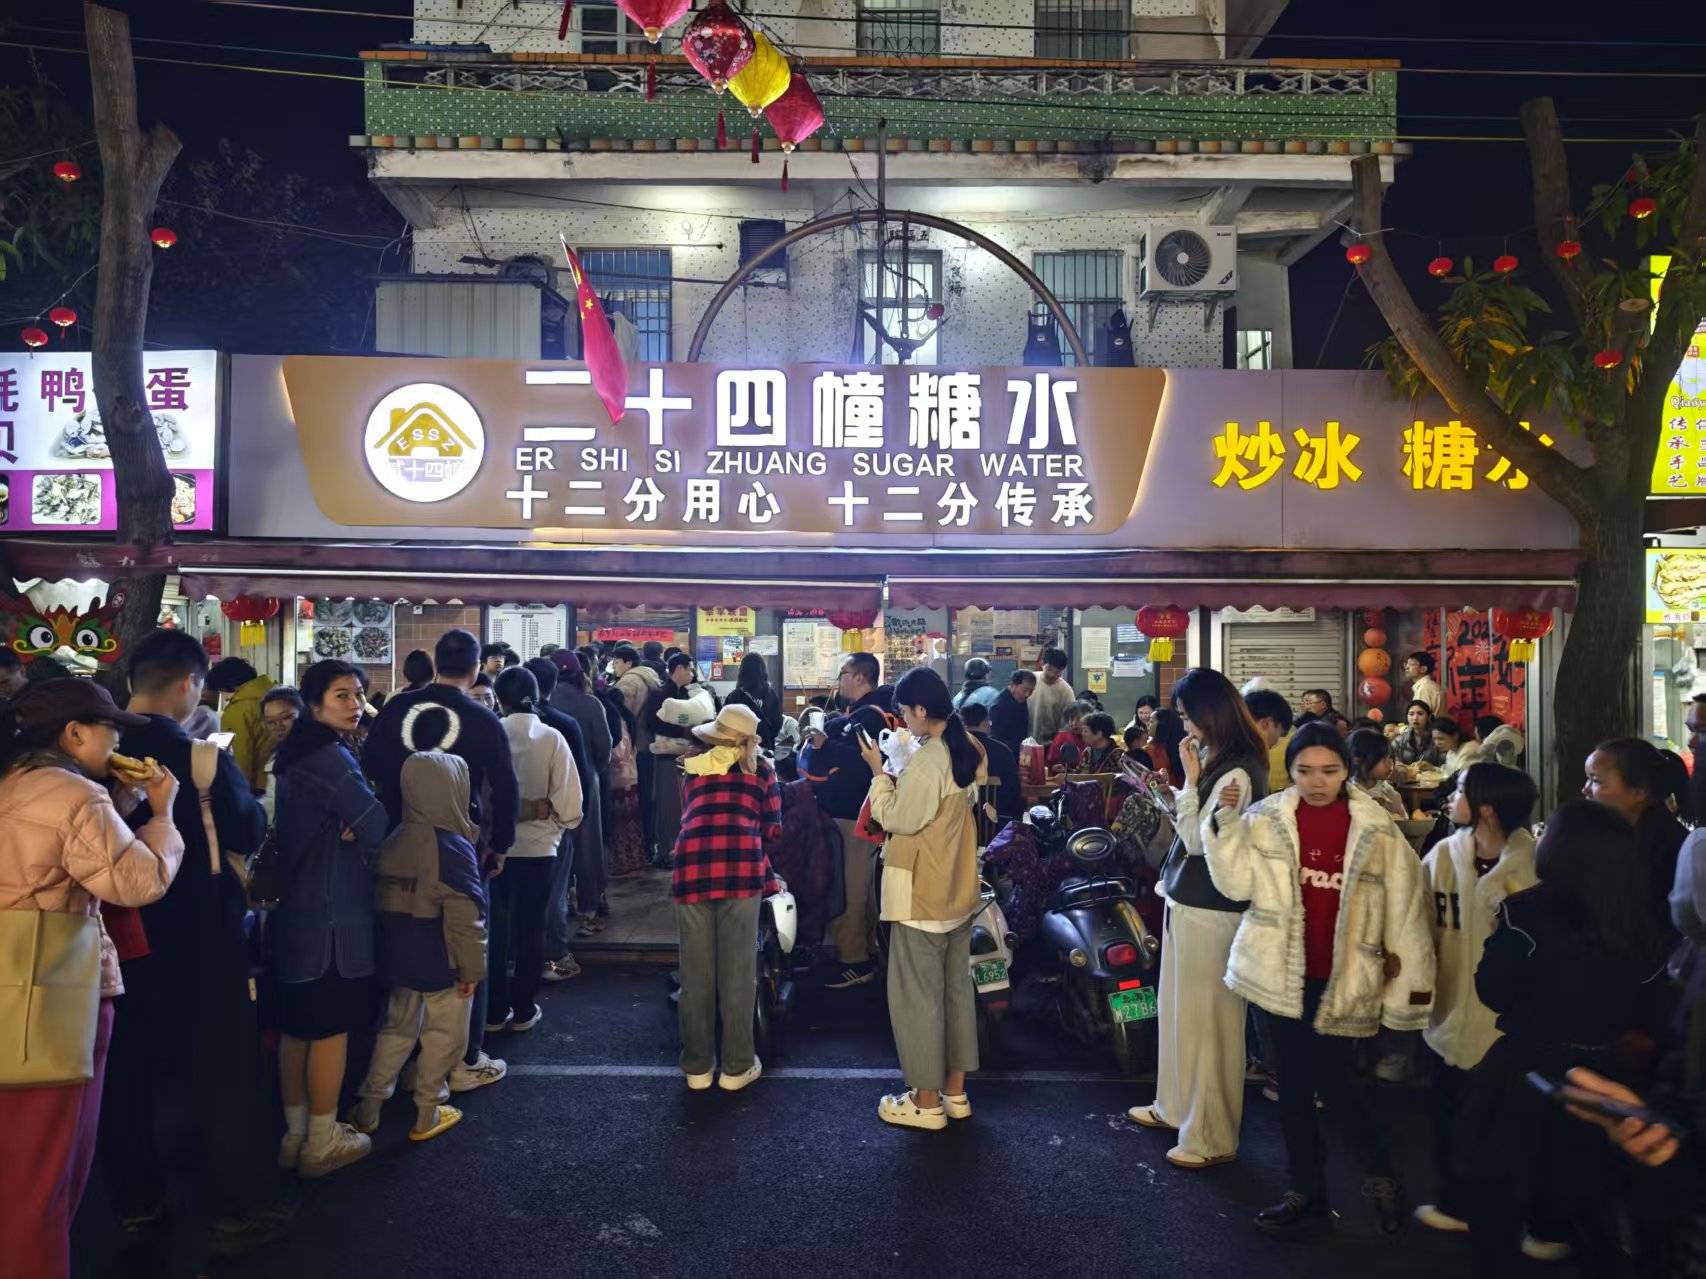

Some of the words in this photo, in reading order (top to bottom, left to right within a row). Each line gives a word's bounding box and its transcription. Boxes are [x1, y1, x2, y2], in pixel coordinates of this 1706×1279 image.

[524, 368, 1082, 450] 二十四幢糖水
[396, 427, 458, 452] ESSZ
[515, 447, 555, 471] ER
[580, 448, 629, 472] SHI
[655, 450, 681, 473] SI
[706, 451, 827, 475] ZHUANG
[853, 453, 955, 476] SUGAR
[980, 454, 1084, 477] WATER
[1204, 421, 1363, 489] 炒冰
[506, 475, 781, 523] 十二分用心
[828, 481, 1094, 527] 十二分传承
